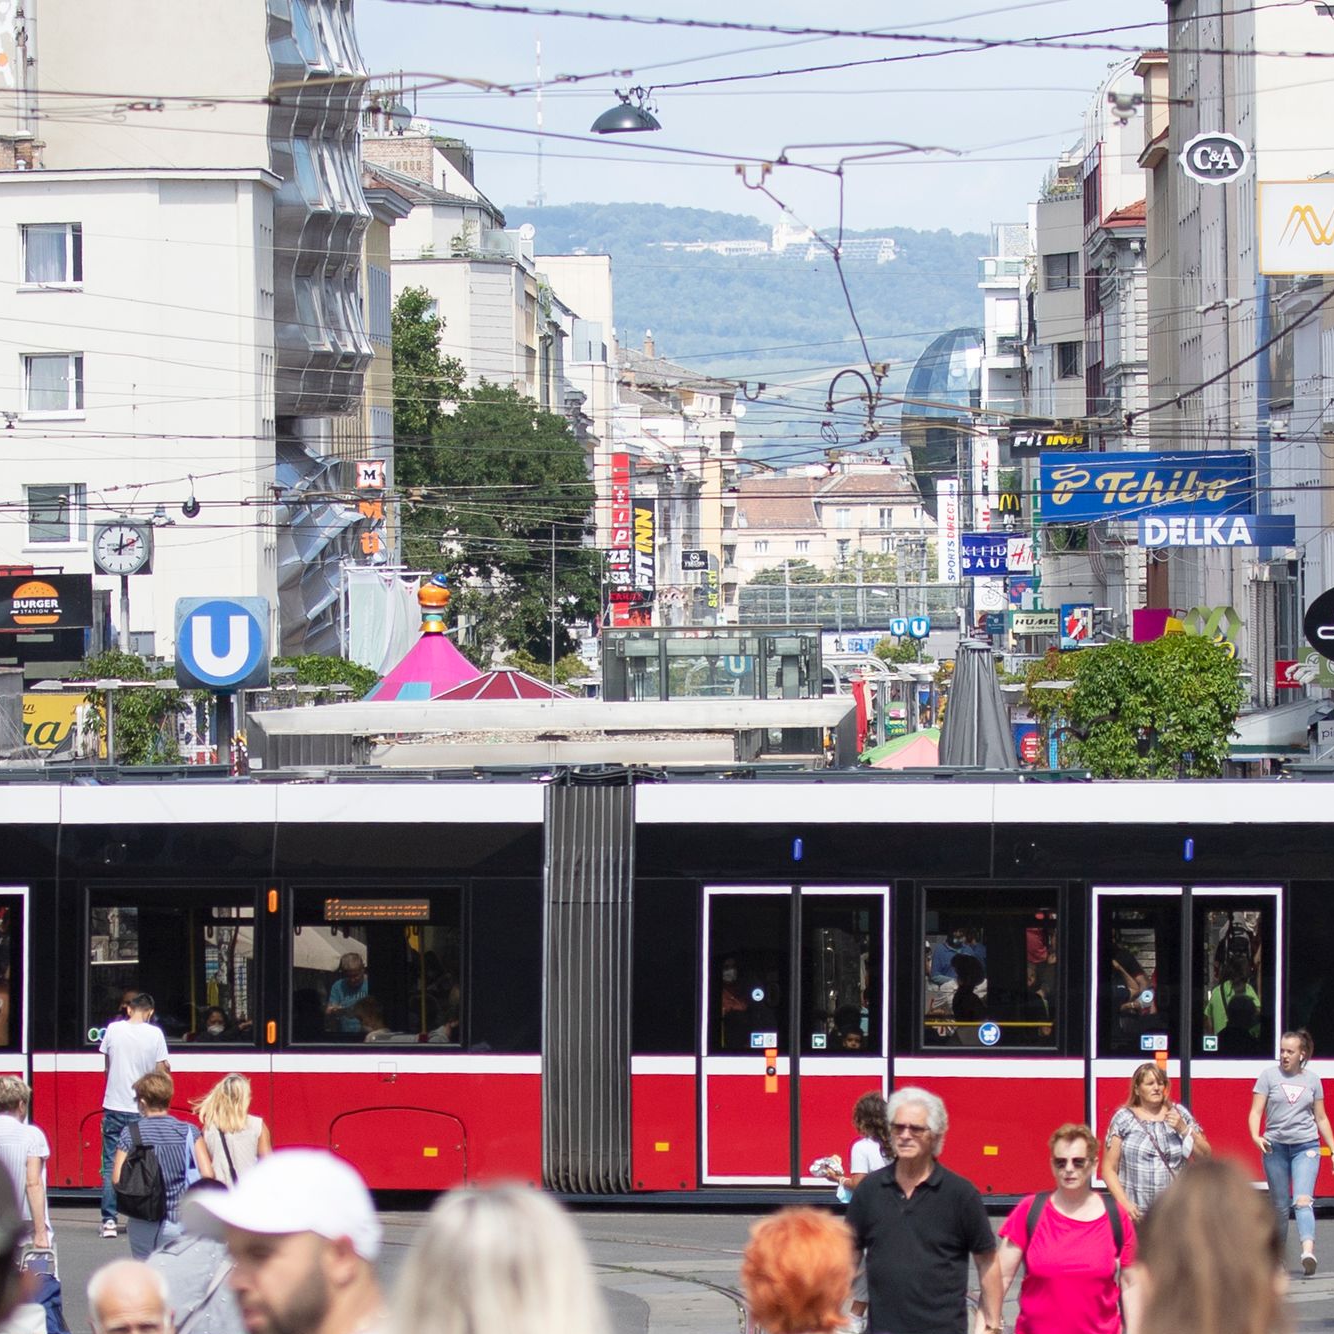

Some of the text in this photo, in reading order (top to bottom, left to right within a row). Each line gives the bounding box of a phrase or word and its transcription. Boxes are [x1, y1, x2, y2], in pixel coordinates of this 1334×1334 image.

[1192, 146, 1239, 171] C&A
[1094, 470, 1239, 505] Tchibo
[1144, 517, 1253, 546] DELKA
[13, 599, 59, 609] BURGER
[191, 615, 251, 677] U
